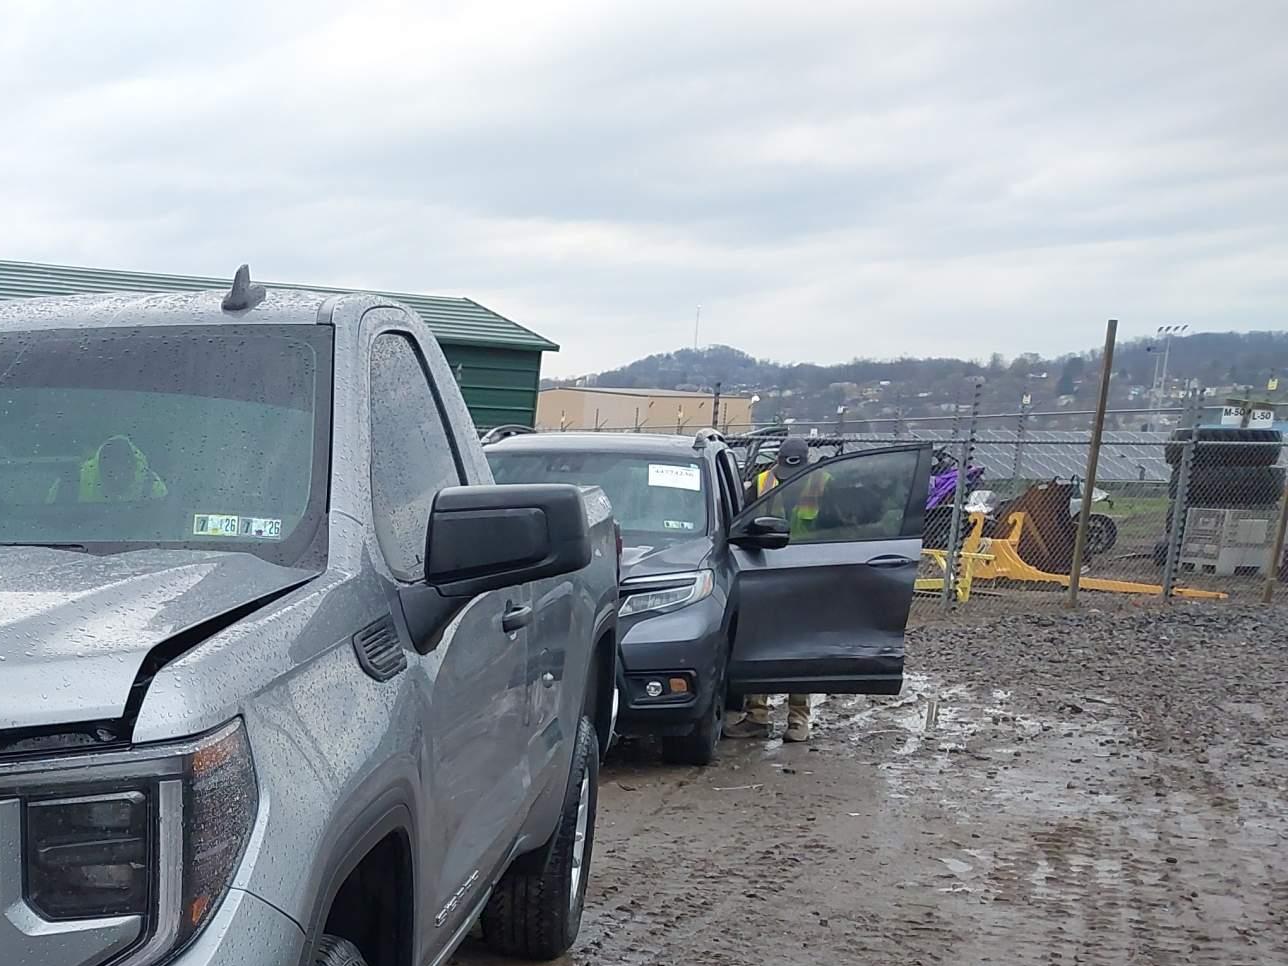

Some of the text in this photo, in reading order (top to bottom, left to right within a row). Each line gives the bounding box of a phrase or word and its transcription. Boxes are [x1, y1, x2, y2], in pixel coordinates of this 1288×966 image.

[1252, 411, 1272, 421] L-50
[224, 518, 236, 532] 26
[268, 520, 280, 535] 26
